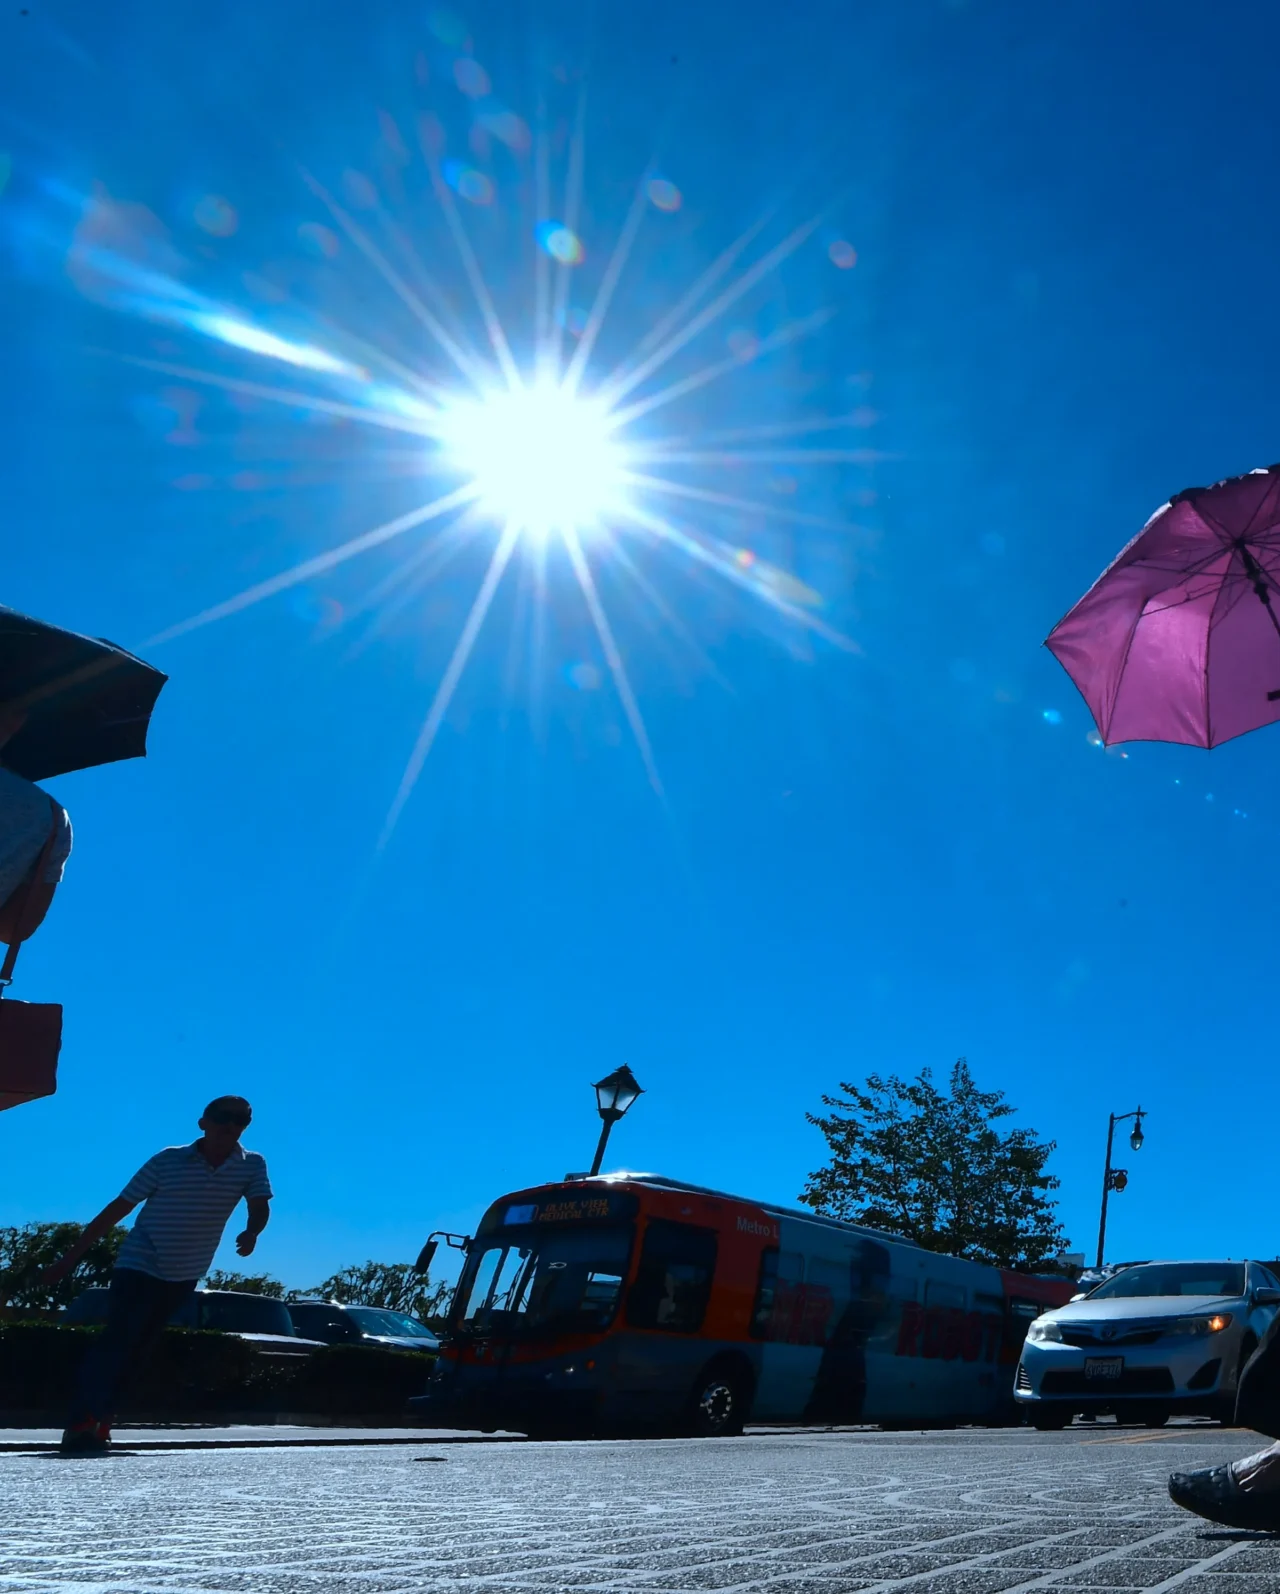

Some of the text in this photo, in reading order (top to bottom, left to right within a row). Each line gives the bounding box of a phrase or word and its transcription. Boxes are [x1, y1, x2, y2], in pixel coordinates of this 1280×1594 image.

[546, 1198, 608, 1213] OLIVE VIEW
[539, 1207, 609, 1221] MEDICAL CTR
[737, 1215, 771, 1237] Metro
